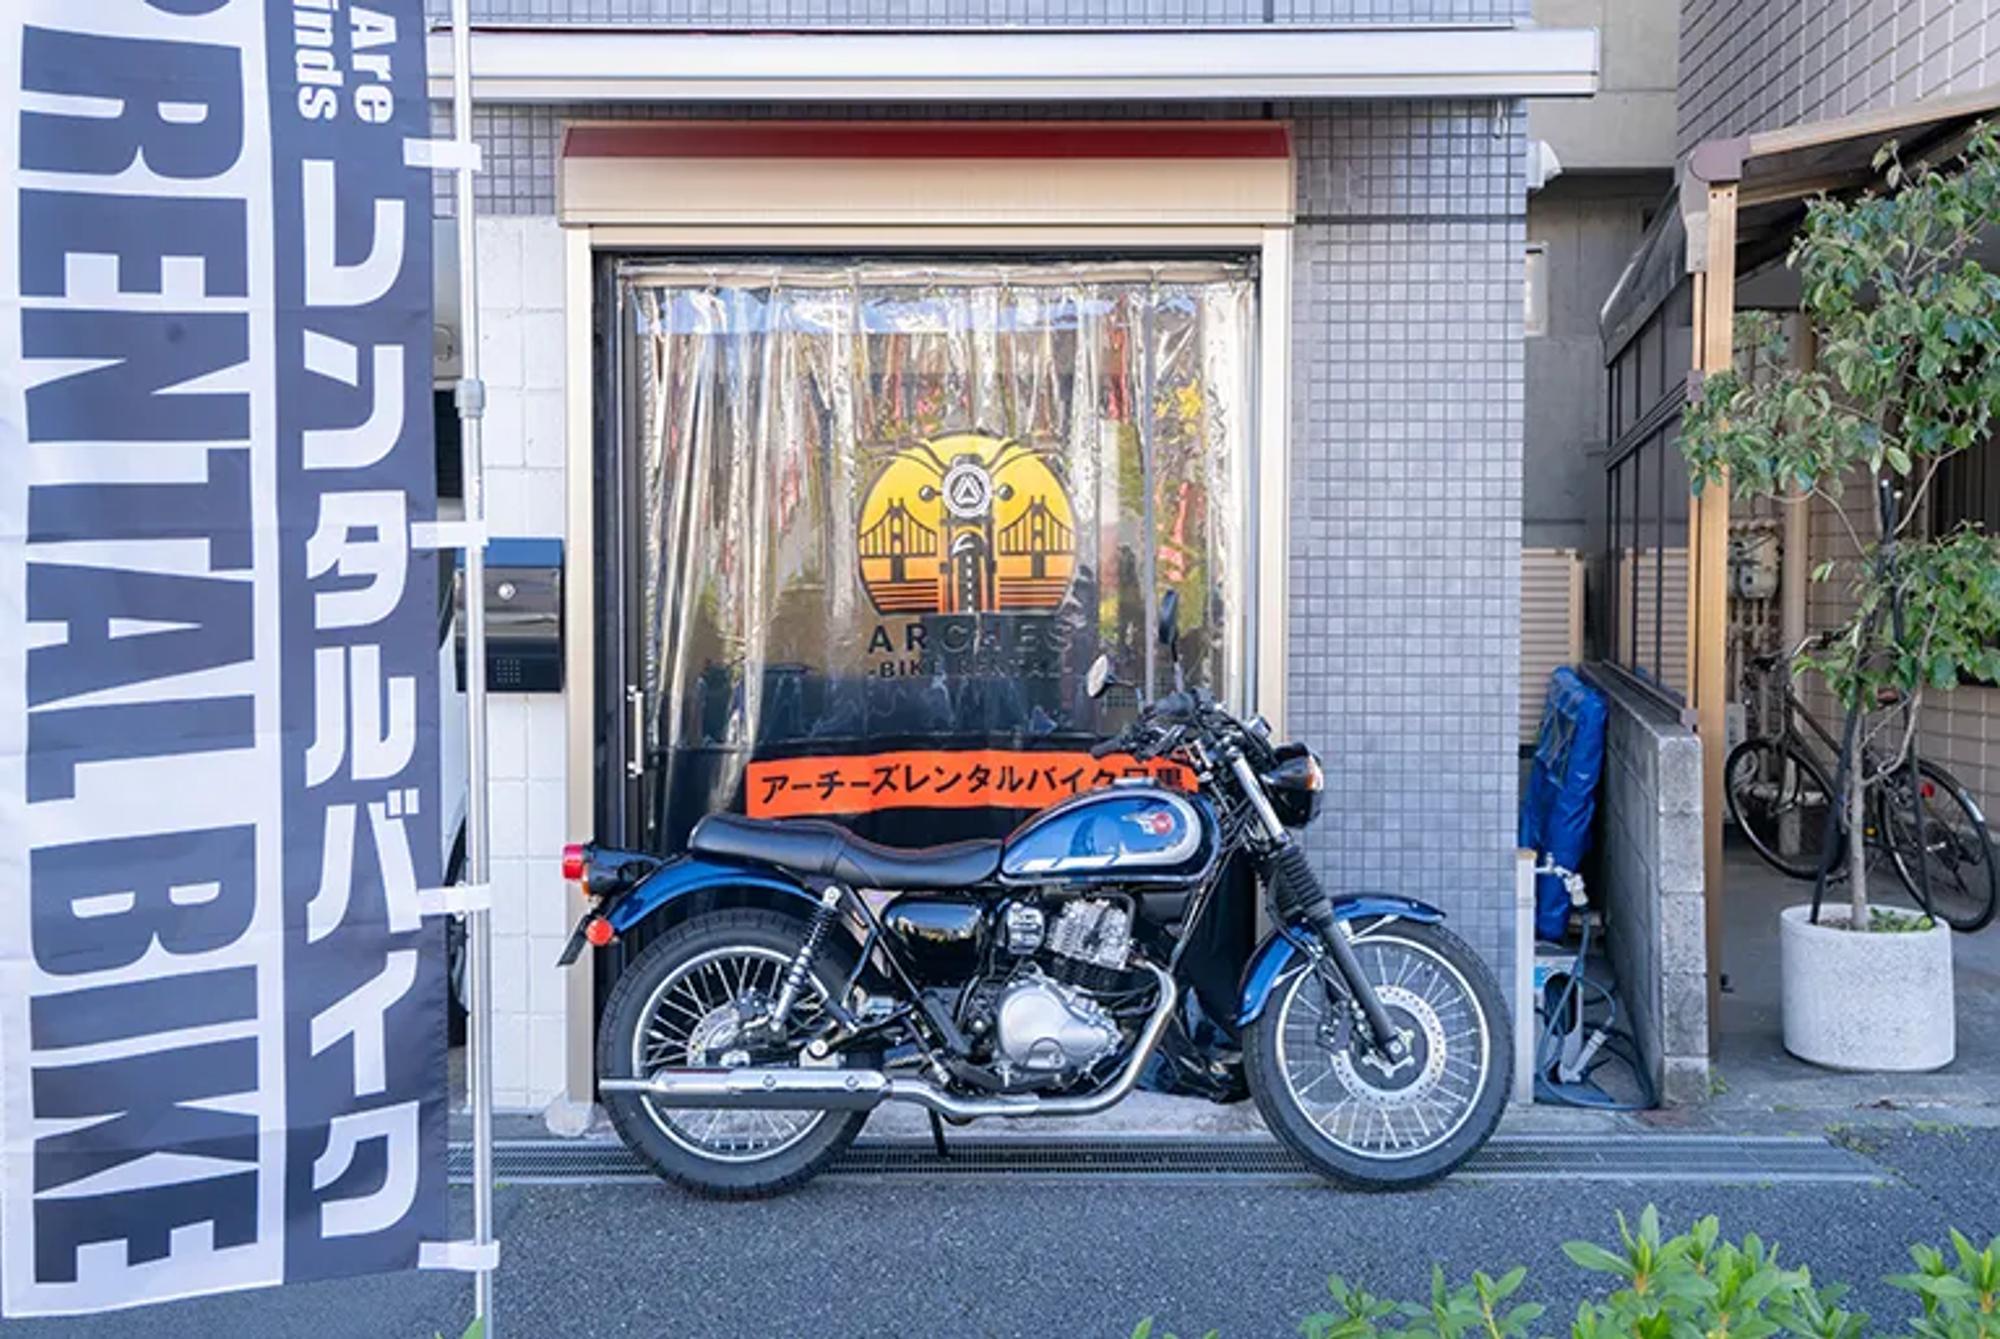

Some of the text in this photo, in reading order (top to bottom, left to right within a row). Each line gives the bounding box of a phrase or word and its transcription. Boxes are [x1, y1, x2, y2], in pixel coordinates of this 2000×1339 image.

[350, 6, 398, 123] Are
[302, 158, 420, 1239] レンタルバイク
